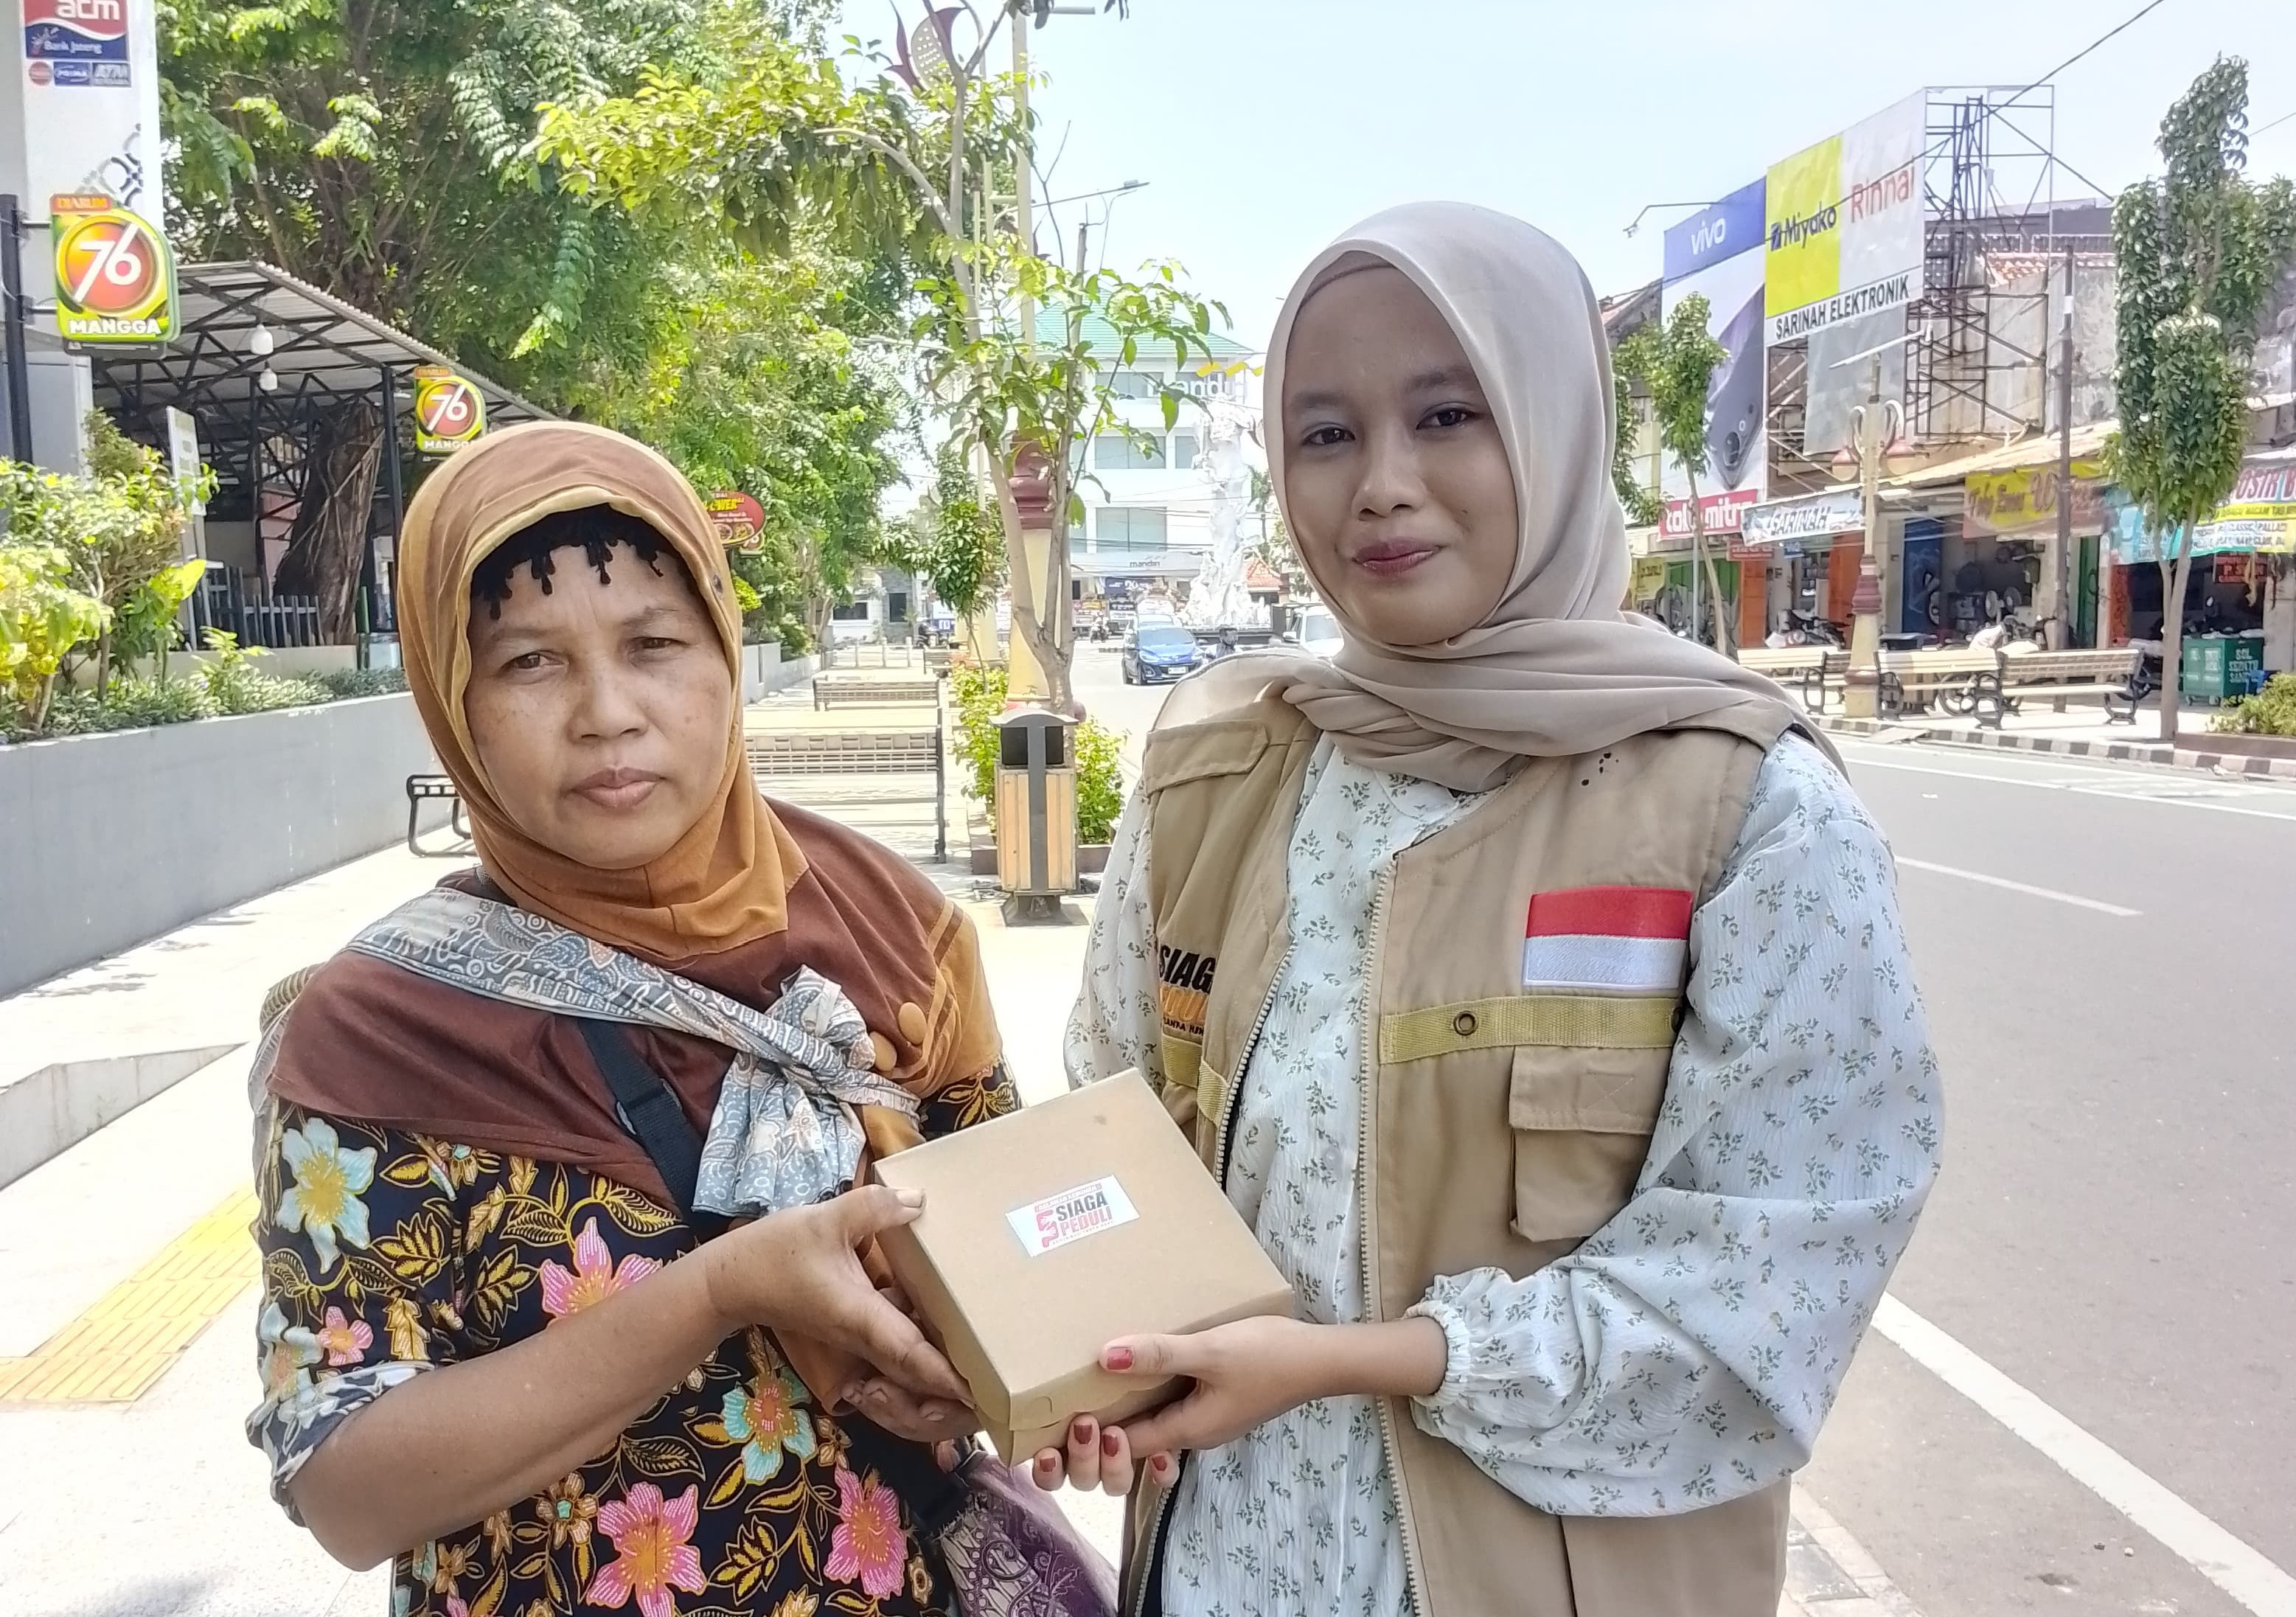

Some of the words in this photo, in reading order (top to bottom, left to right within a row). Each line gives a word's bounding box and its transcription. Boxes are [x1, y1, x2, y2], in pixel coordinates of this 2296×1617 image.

[55, 0, 120, 20] atm
[1850, 167, 1915, 223] Rinnai
[1691, 218, 1727, 255] vivo
[1783, 201, 1837, 249] Miyako
[74, 223, 141, 302] 76
[69, 319, 161, 335] MANGGA
[1775, 304, 1826, 341] SARINAH
[1830, 275, 1910, 321] ELEKTRONIK
[427, 384, 467, 432] 76
[1159, 942, 1217, 994] SIAG
[1056, 1190, 1108, 1222] SIAGA
[1060, 1206, 1113, 1236] PEDULI
